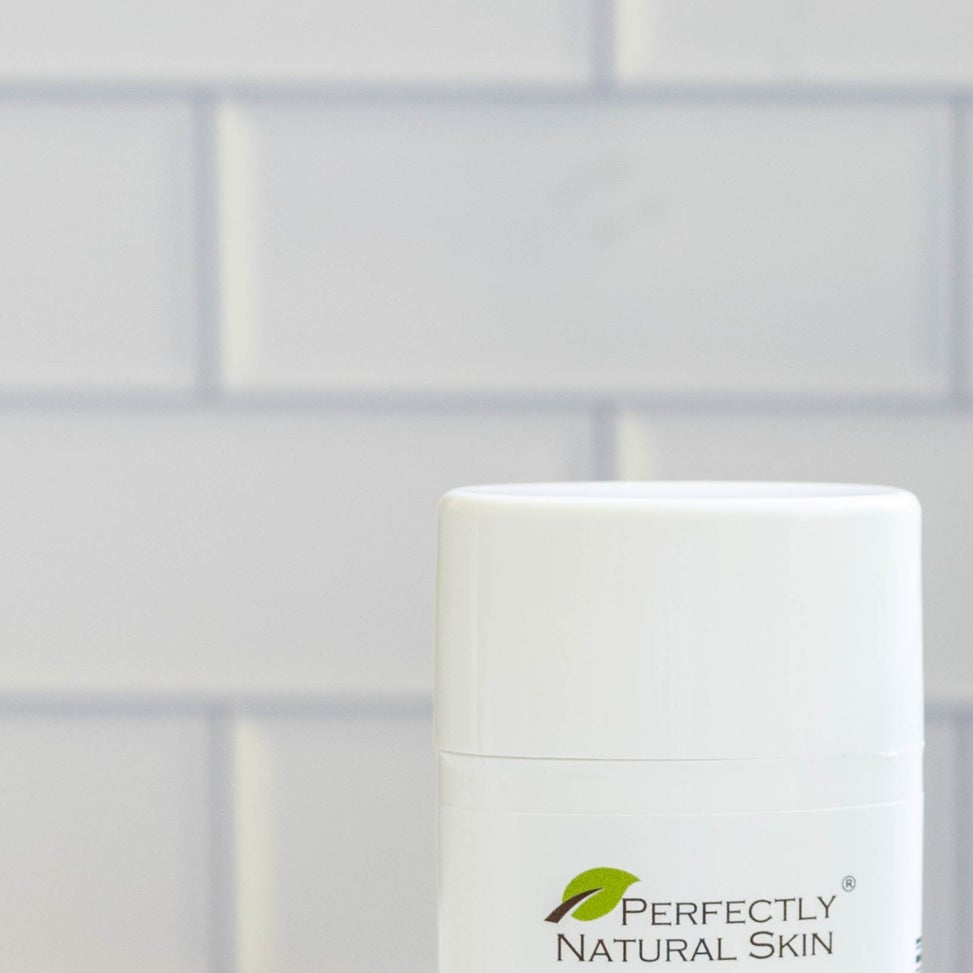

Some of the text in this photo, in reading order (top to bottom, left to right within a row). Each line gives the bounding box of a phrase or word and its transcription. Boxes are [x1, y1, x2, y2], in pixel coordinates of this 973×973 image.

[621, 895, 836, 926] PERFECTLY
[556, 931, 833, 963] NATURAL SKIN
